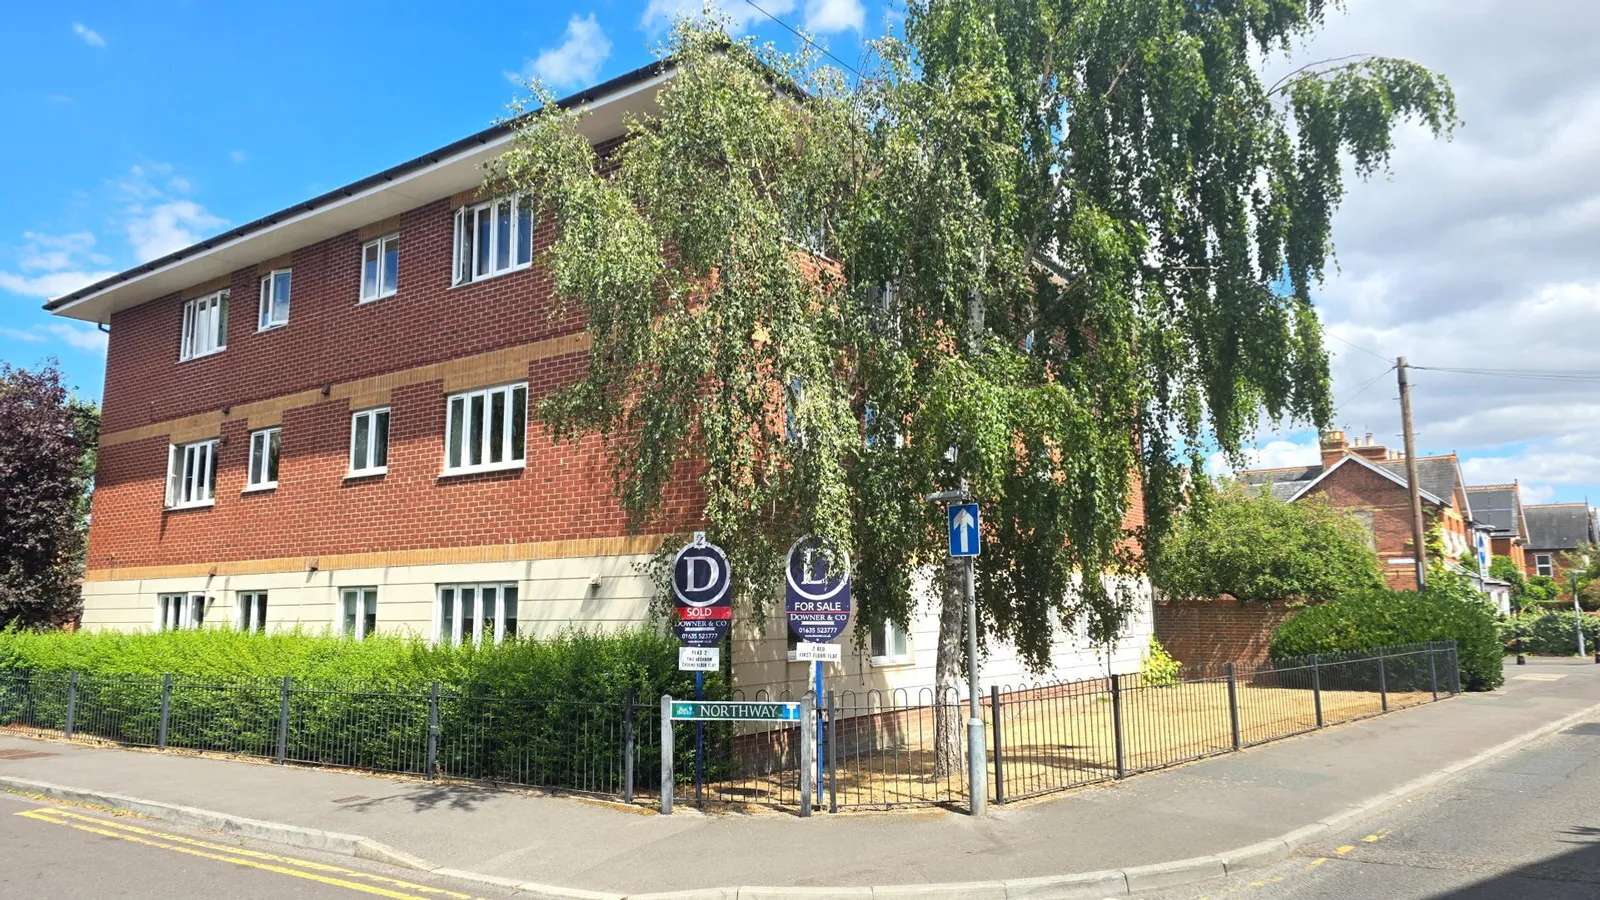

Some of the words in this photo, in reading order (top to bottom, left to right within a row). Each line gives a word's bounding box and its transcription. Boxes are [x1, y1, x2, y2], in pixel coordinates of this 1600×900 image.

[696, 534, 703, 546] 2
[683, 556, 719, 592] D
[687, 607, 712, 617] SOLD
[794, 602, 815, 611] FOR
[816, 602, 842, 611] SALE
[790, 613, 826, 621] DOWNER
[700, 704, 778, 717] NORTHWAY
